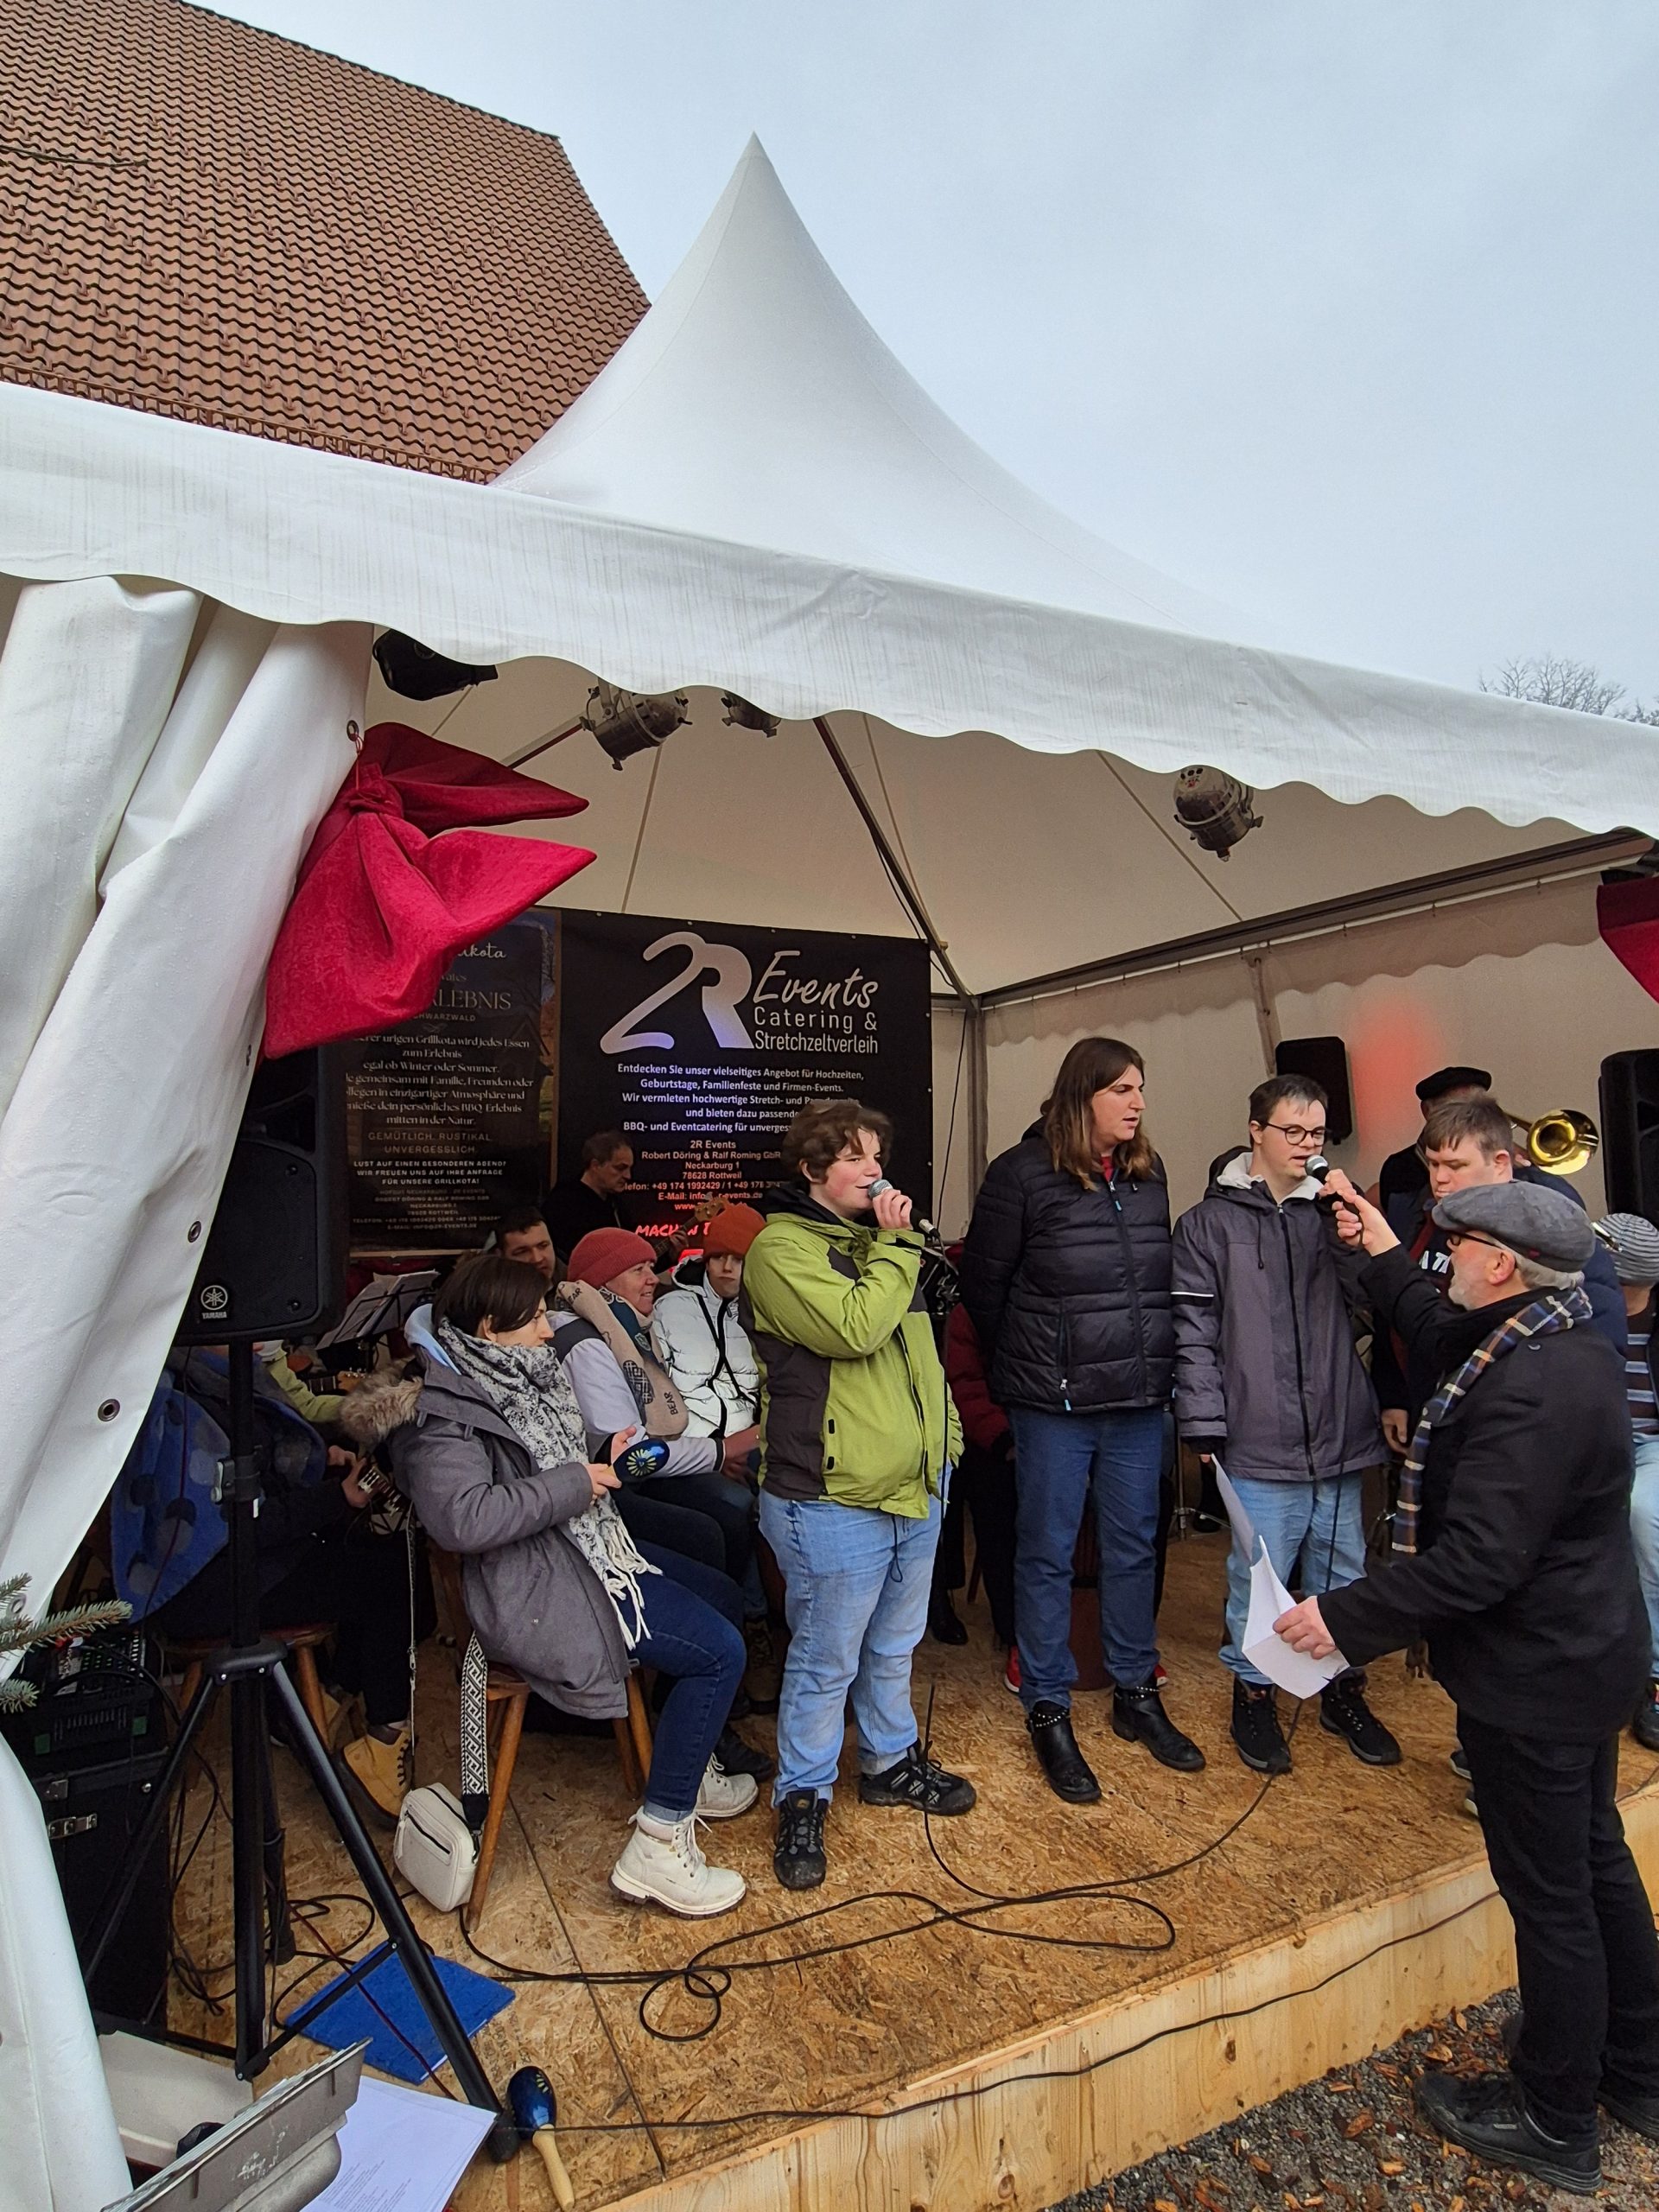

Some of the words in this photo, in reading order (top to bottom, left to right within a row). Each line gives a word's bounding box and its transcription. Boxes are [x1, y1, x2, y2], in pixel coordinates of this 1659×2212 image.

[753, 950, 879, 1009] Events
[754, 1007, 854, 1033] Catering
[864, 1012, 877, 1030] &
[754, 1030, 878, 1053] Stretchzeltverleih
[618, 1064, 667, 1075] Entdecken
[669, 1065, 683, 1075] Sie
[685, 1067, 711, 1076] unser
[713, 1066, 762, 1077] vielseitiges
[763, 1068, 800, 1078] Angebot
[801, 1069, 814, 1078] für
[816, 1070, 864, 1080] Hochzeiten,
[640, 1078, 701, 1091] Geburtstage,
[702, 1079, 762, 1090] Familienfeste
[764, 1081, 780, 1090] und
[782, 1082, 844, 1093] Firmen-Events.
[622, 1092, 640, 1103] Wir
[642, 1093, 690, 1103] vermieten
[692, 1094, 748, 1105] hochwertige
[749, 1094, 784, 1104] Stretch-
[785, 1096, 803, 1105] und
[685, 1108, 703, 1117] und
[705, 1108, 734, 1118] bieten
[736, 1109, 758, 1118] dazu
[623, 1122, 648, 1132] BBQ-
[650, 1122, 669, 1131] und
[671, 1122, 733, 1134] Eventcatering
[734, 1122, 748, 1132] für
[705, 1140, 736, 1149] Events
[641, 1151, 671, 1160] Robert
[672, 1151, 701, 1160] Döring
[712, 1151, 728, 1160] Ralf
[730, 1152, 761, 1160] Roming
[685, 1161, 734, 1171] Neckarburg
[624, 1182, 650, 1191] lefon:
[567, 1287, 583, 1306] EAR
[663, 1390, 679, 1416] BEAR
